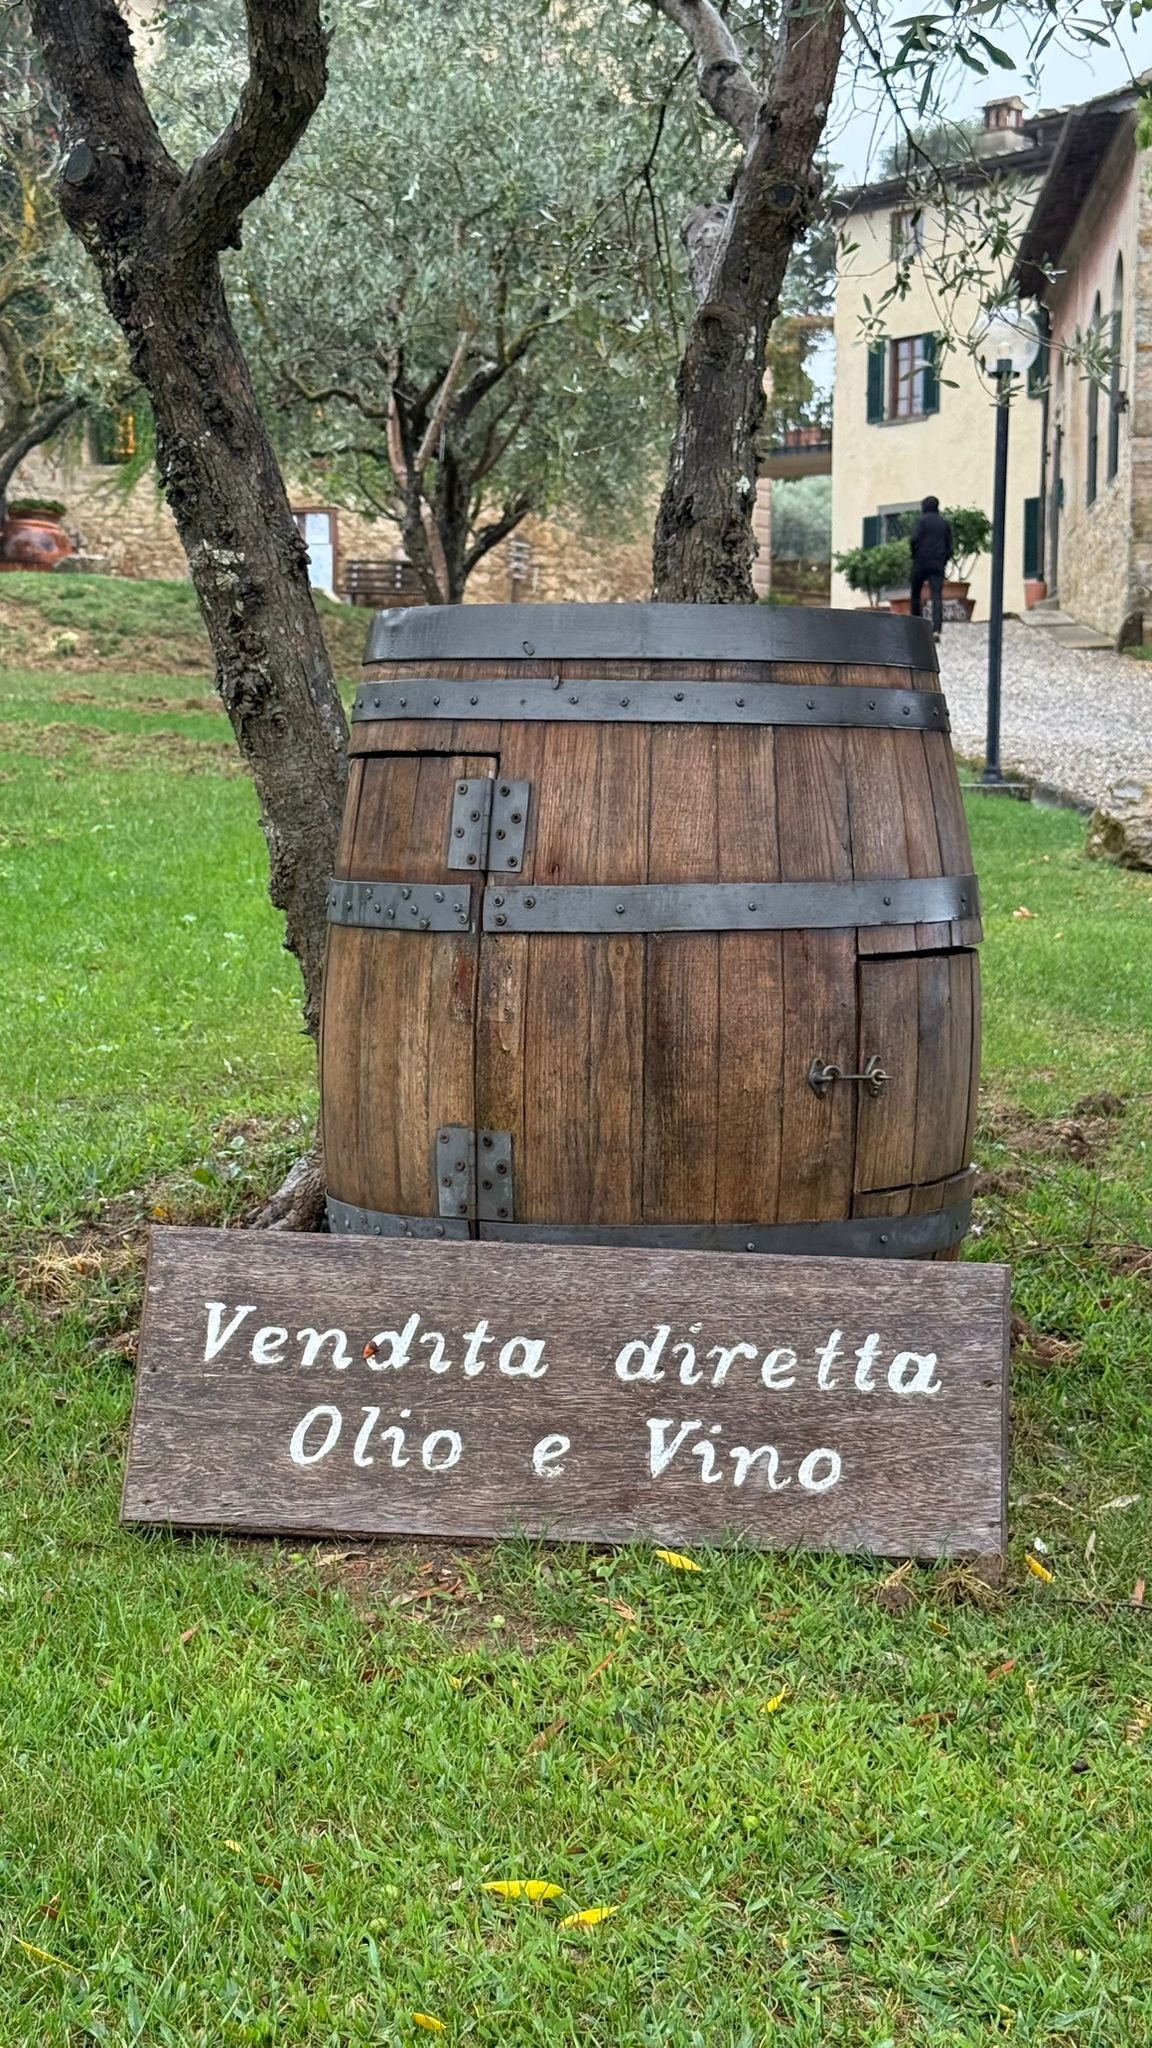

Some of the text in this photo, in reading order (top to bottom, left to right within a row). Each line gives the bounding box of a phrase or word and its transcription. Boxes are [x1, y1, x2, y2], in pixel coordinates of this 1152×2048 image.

[204, 1301, 942, 1394] Vendita diretta
[290, 1405, 842, 1490] Olio e Vino
